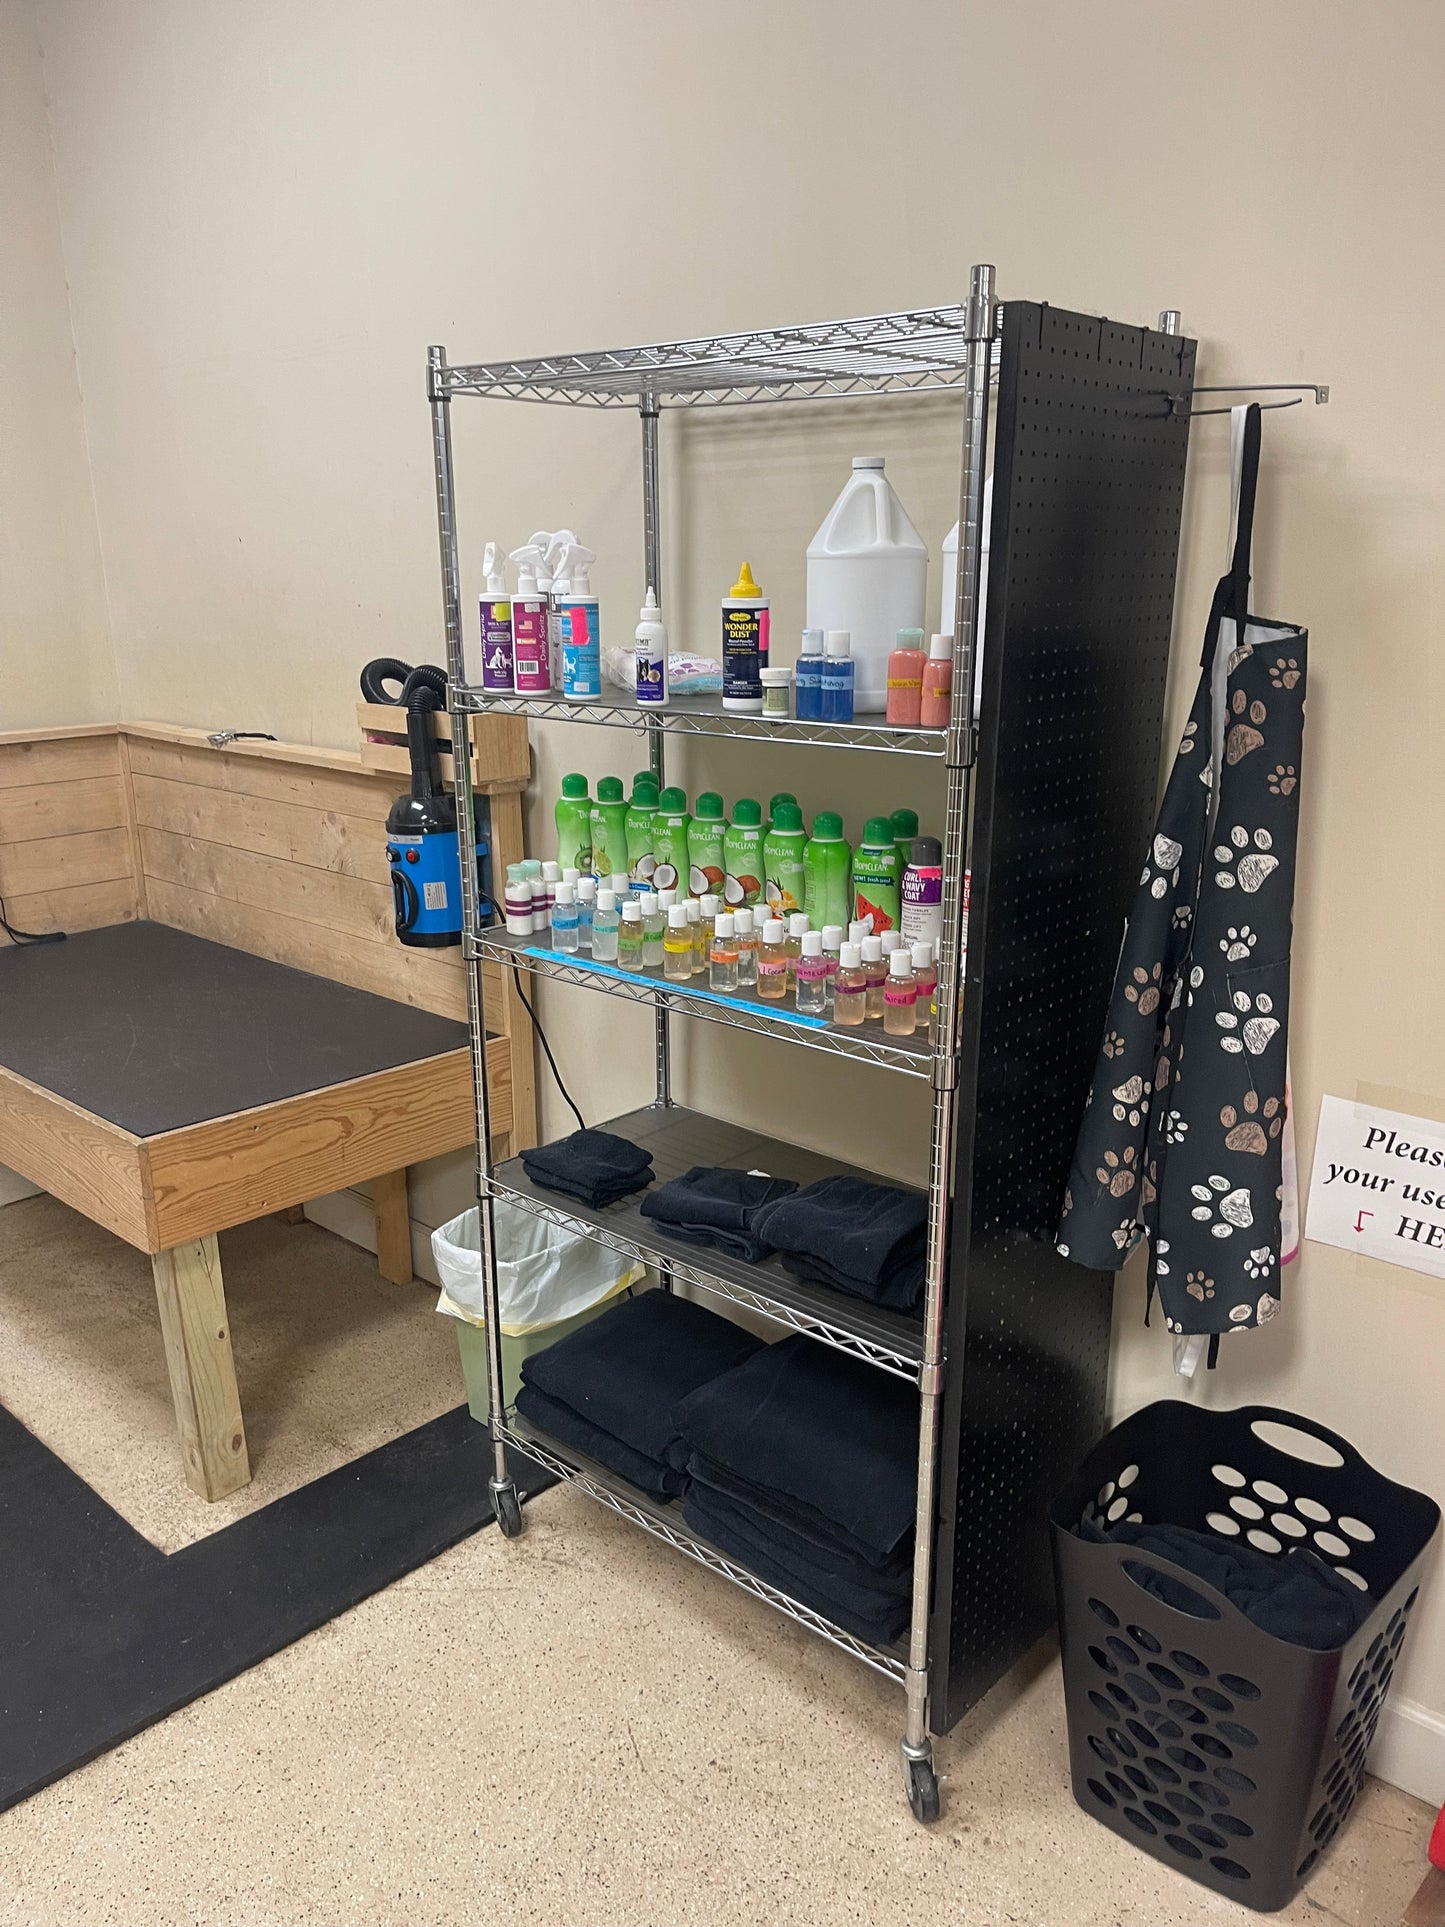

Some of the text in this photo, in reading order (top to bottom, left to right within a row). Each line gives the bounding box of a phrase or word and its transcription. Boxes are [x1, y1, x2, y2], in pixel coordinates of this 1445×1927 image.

[538, 615, 546, 641] Spritz
[724, 623, 758, 631] WONDER
[904, 891, 920, 901] COAT
[906, 883, 926, 892] WAVY
[1362, 1126, 1445, 1168] Pleas
[1322, 1163, 1395, 1193] your
